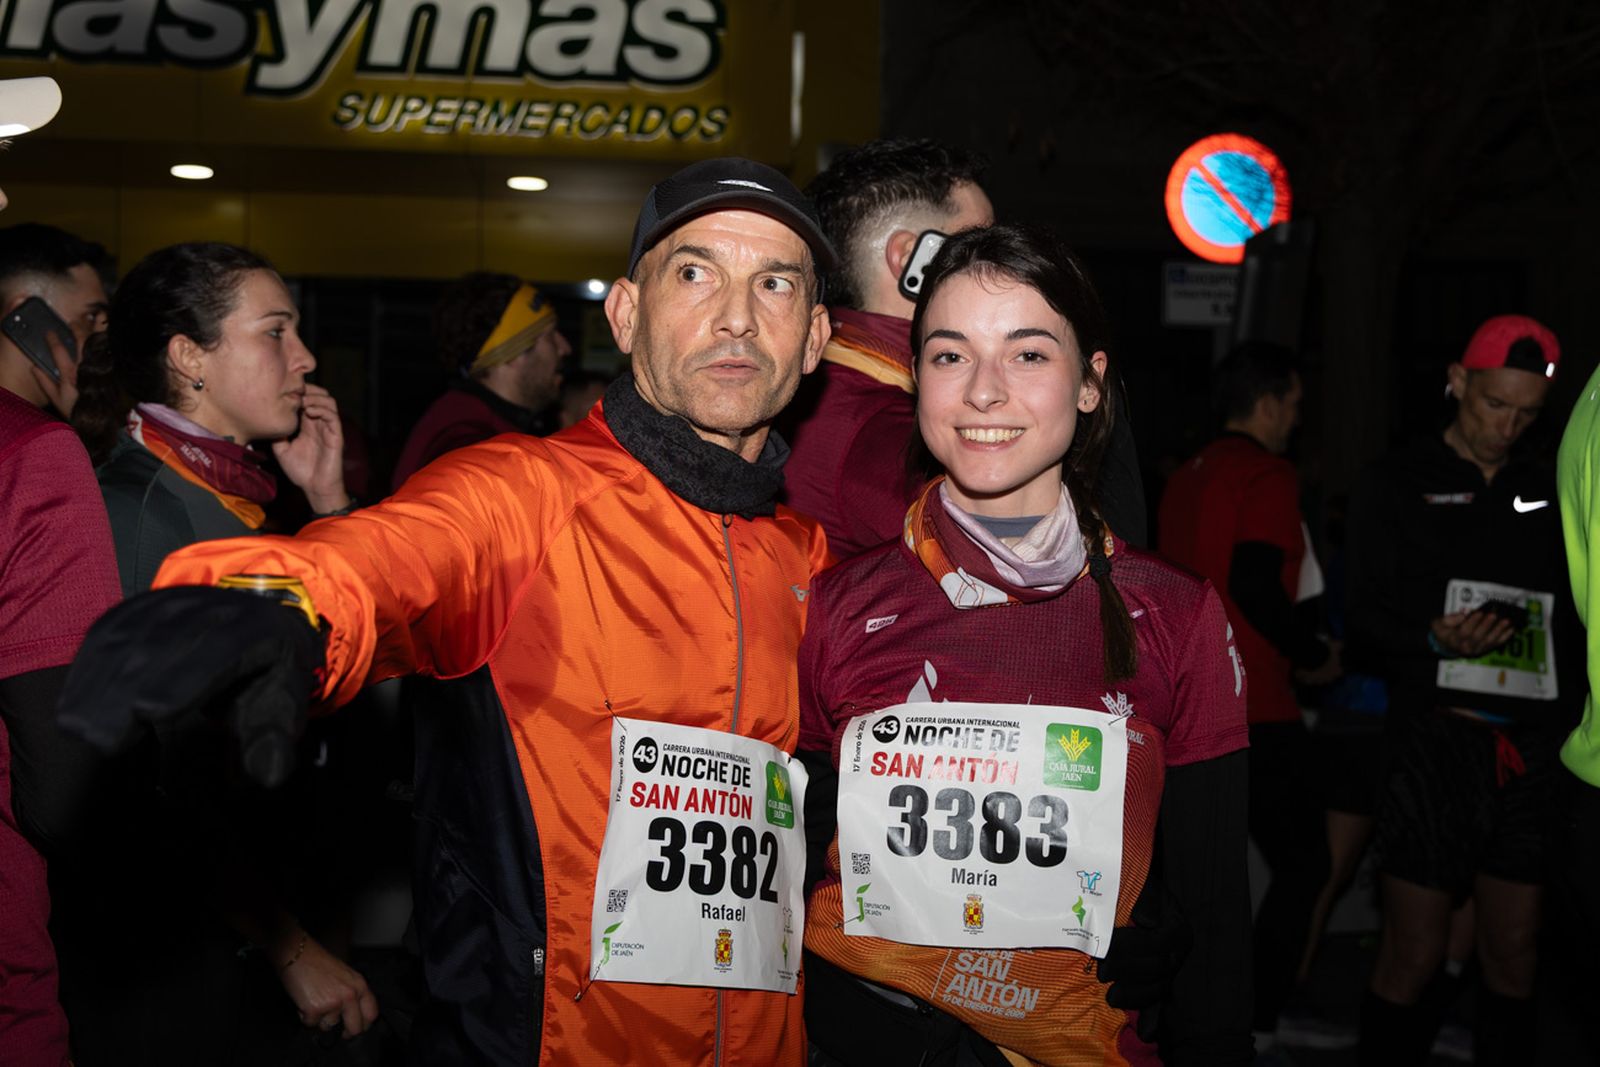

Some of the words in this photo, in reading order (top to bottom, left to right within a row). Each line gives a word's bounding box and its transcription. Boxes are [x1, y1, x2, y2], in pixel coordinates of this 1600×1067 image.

[335, 92, 728, 142] SUPERMERCADOS
[873, 720, 898, 735] 43
[937, 717, 965, 725] URBANA
[966, 718, 1020, 729] INTERNACIONAL
[855, 732, 863, 740] de
[904, 725, 985, 750] NOCHE
[989, 729, 1020, 752] DE
[633, 745, 657, 764] 43
[663, 743, 690, 754] CARRERA
[692, 746, 714, 757] URBANA
[716, 751, 751, 765] INTERNACIONAL
[854, 741, 862, 762] Enero
[661, 754, 728, 784] NOCHE
[731, 764, 751, 788] DE
[853, 764, 860, 772] 17
[871, 751, 924, 778] SAN
[928, 752, 1018, 785] ANTÓN
[1049, 762, 1068, 771] CAJA
[1070, 763, 1096, 775] RURAL
[630, 781, 680, 811] SAN
[684, 787, 753, 820] ANTÓN
[887, 784, 1069, 868] 3383
[646, 817, 778, 903] 3382
[951, 867, 997, 887] María
[702, 902, 746, 922] Rafael
[954, 952, 1012, 981] SAN
[945, 973, 1040, 1012] ANTÓN
[992, 1006, 1004, 1015] DE
